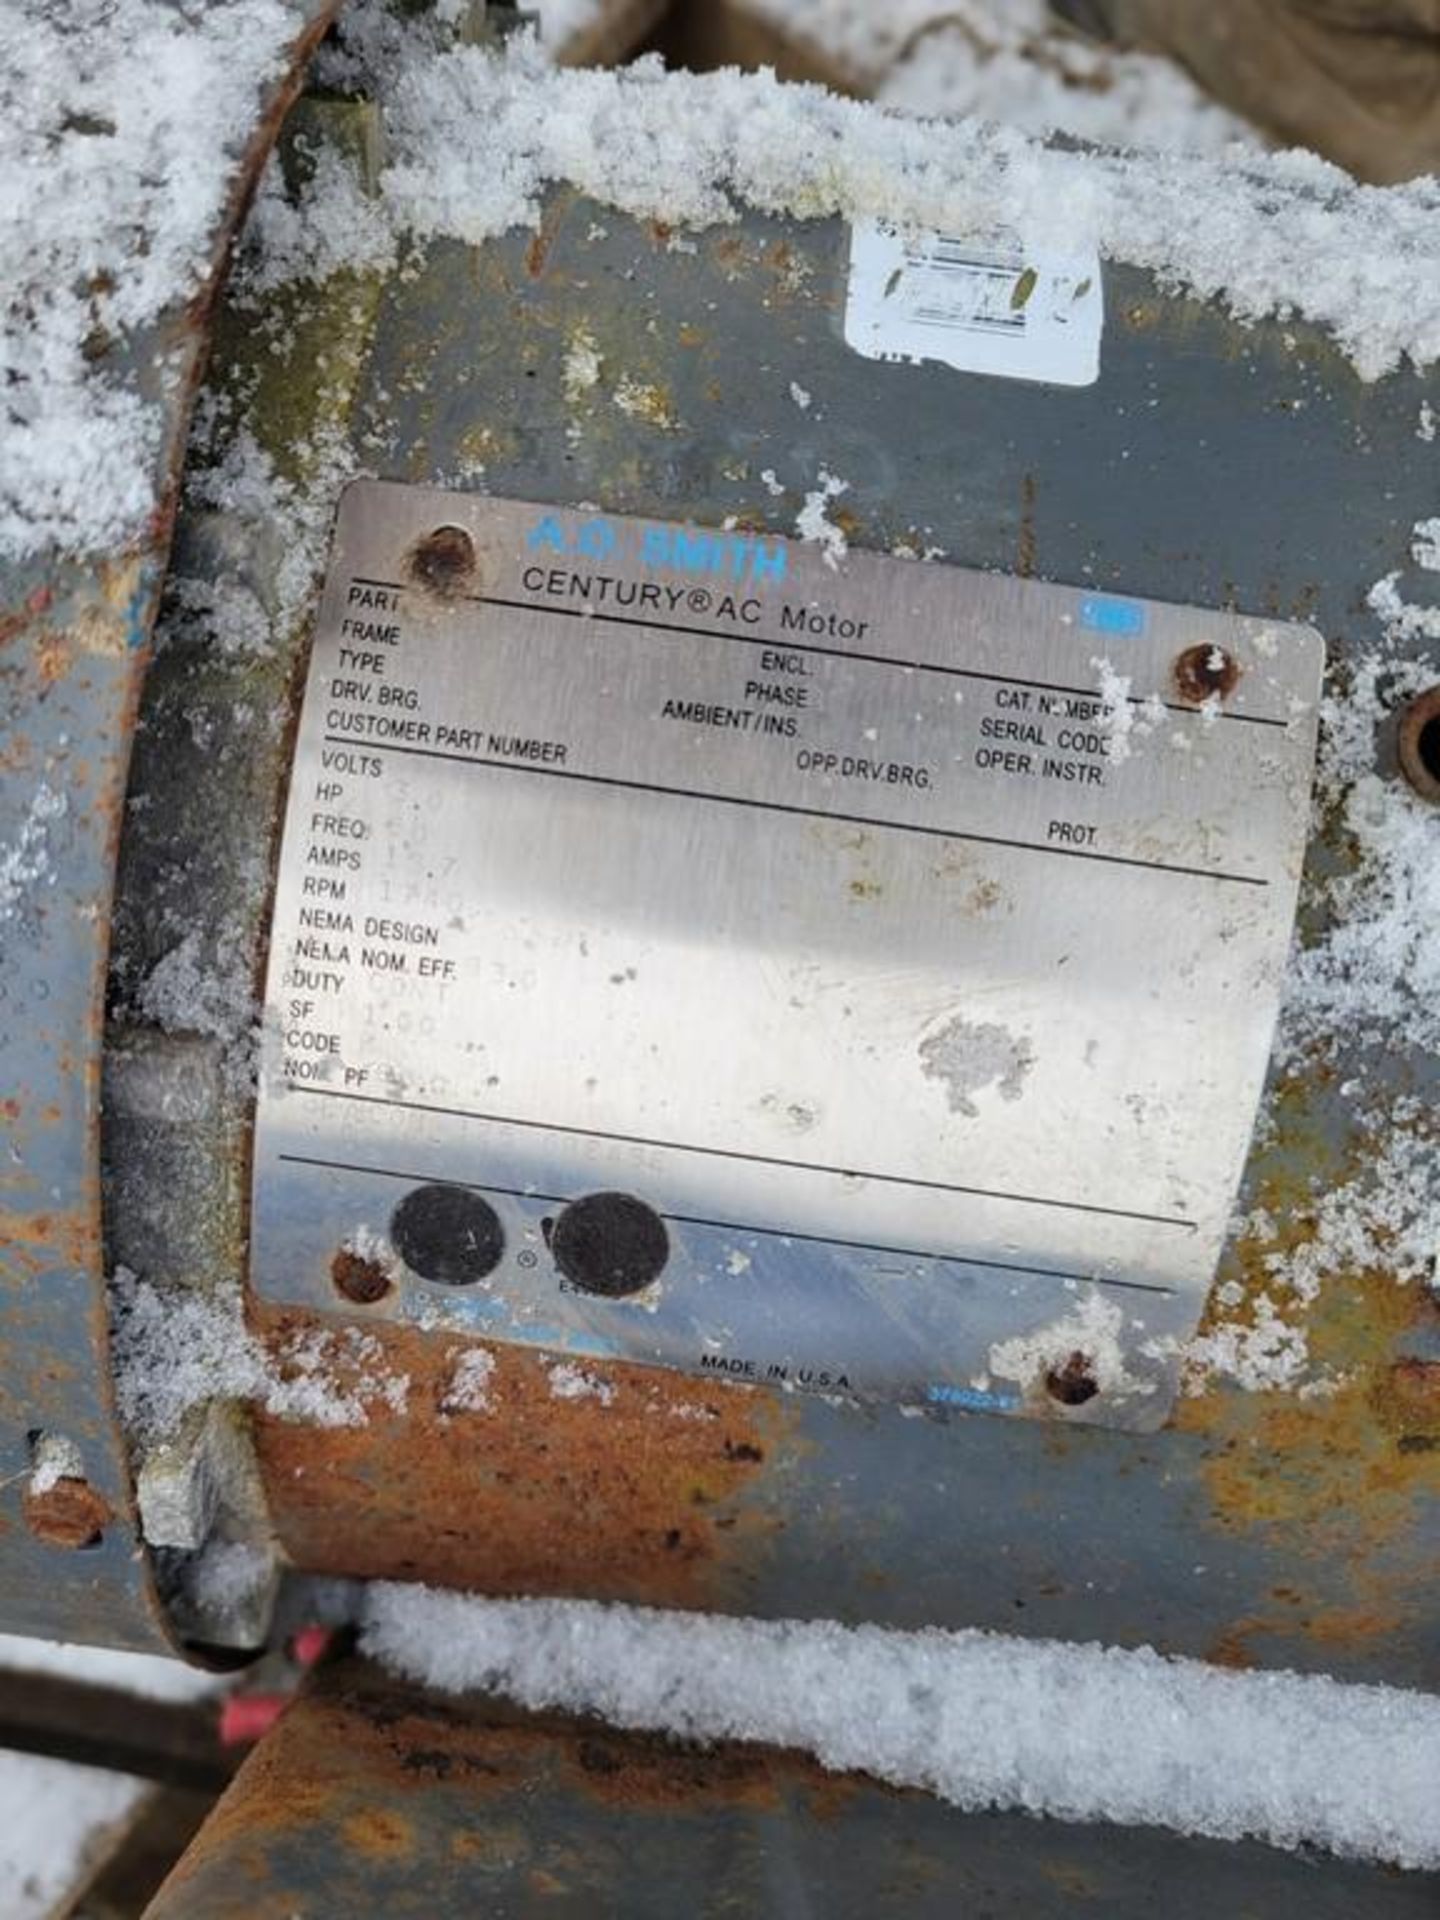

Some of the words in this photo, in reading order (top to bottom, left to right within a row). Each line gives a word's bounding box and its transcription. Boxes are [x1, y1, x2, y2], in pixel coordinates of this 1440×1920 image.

[347, 586, 403, 612] PART
[341, 618, 401, 646] FRAME
[780, 604, 870, 640] Motor
[339, 649, 385, 674] TYPE
[761, 650, 813, 676] ENCL.
[331, 679, 372, 704] DRV.
[378, 685, 421, 711] BRG.
[744, 681, 808, 708] PHASE
[996, 688, 1032, 713] CAT.
[327, 709, 430, 743] CUSTOMER
[435, 726, 482, 751] PART
[488, 735, 568, 765] NUMBER
[980, 717, 1047, 747] SERIAL
[1057, 729, 1112, 756] CODE
[321, 749, 383, 778] VOLTS
[975, 748, 1036, 776] OPER.
[1042, 758, 1106, 787] INSTR.
[315, 781, 344, 801] HP
[307, 845, 361, 871] AMPS
[303, 875, 346, 900] RPM
[299, 907, 354, 932] NEMA
[365, 916, 439, 946] DESIGN
[291, 968, 346, 994] DUTY
[290, 999, 315, 1019] SF
[286, 1029, 341, 1054] CODE
[344, 1066, 368, 1088] PF
[700, 1353, 757, 1377] MADE
[767, 1363, 789, 1381] IN
